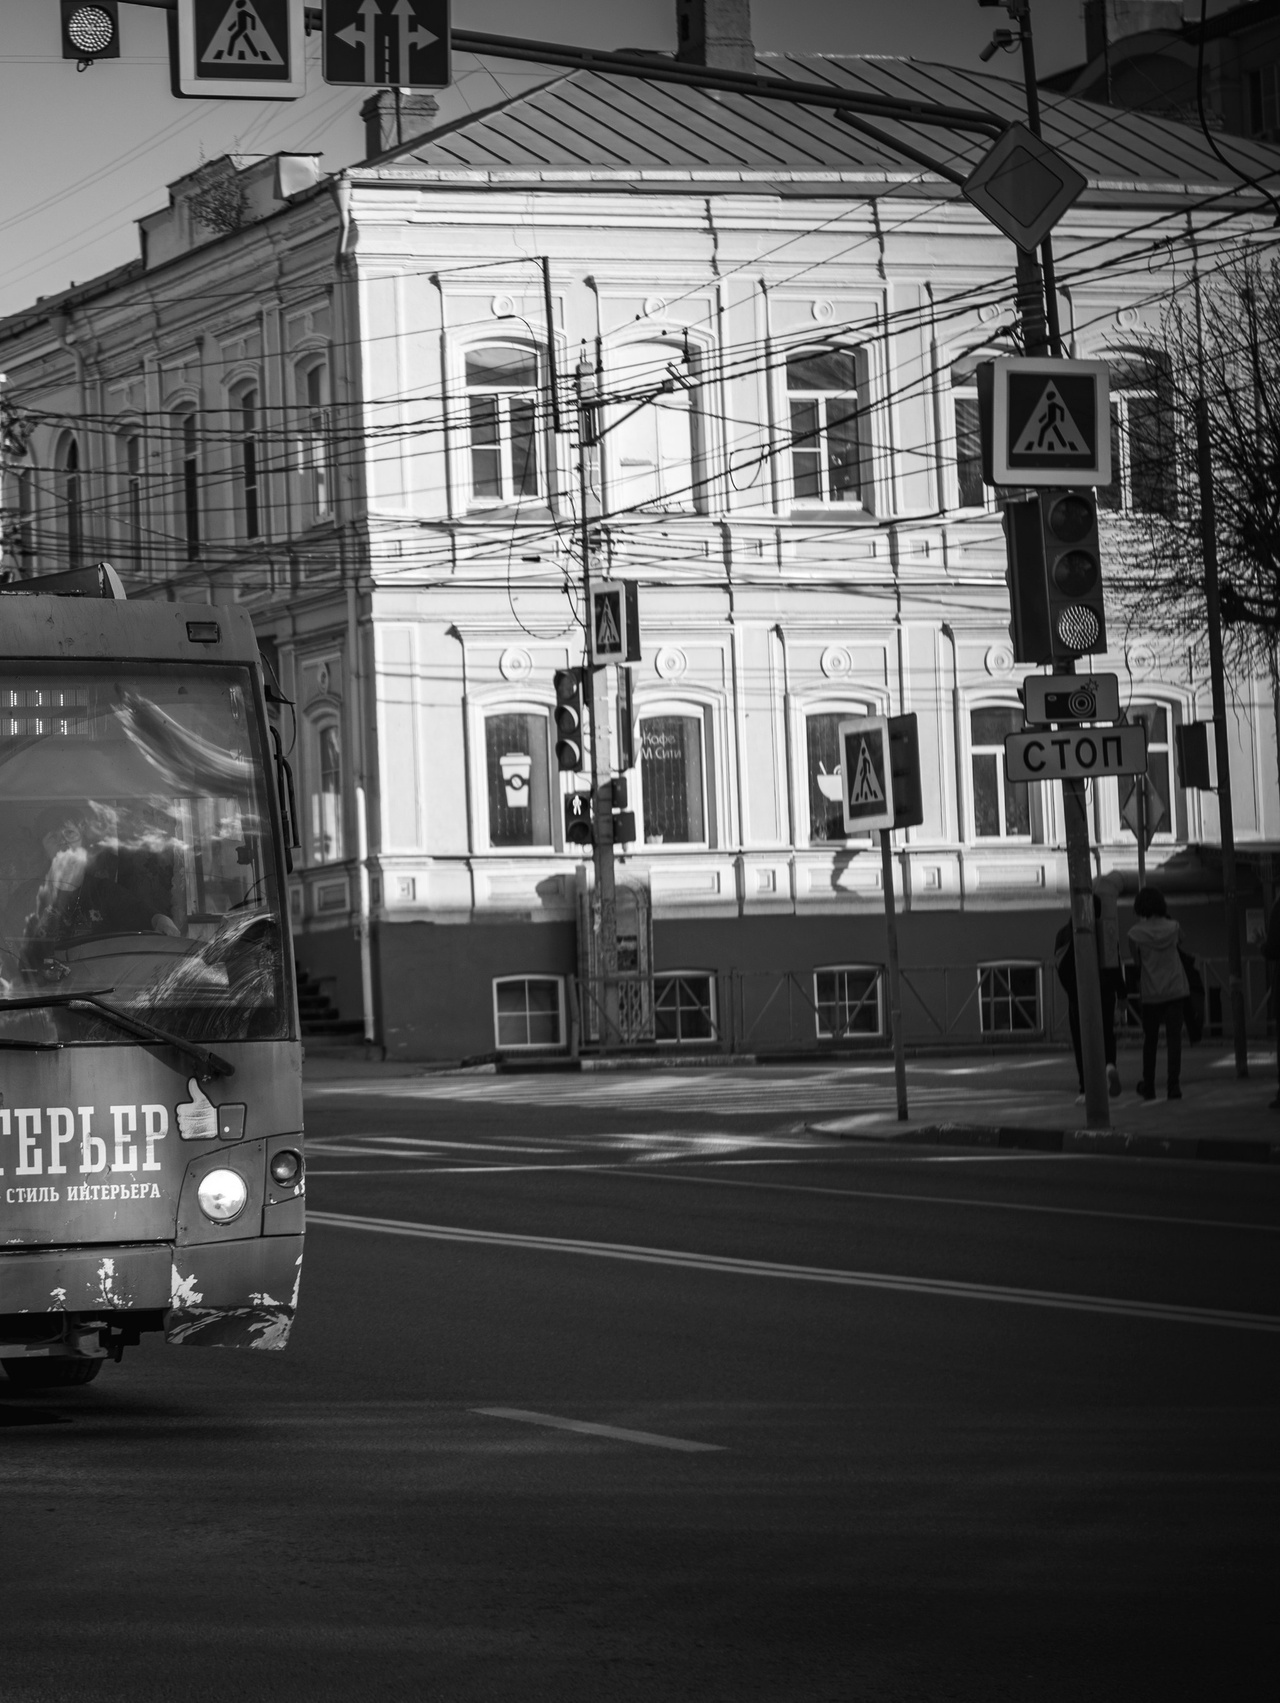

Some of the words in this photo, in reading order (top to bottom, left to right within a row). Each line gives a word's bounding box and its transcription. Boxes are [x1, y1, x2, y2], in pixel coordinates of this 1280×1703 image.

[642, 730, 676, 747] Кафе
[1024, 736, 1122, 772] СТОП
[6, 1187, 60, 1203] СТИЛЬ
[67, 1183, 161, 1201] ИНТЕРЬЕРА
